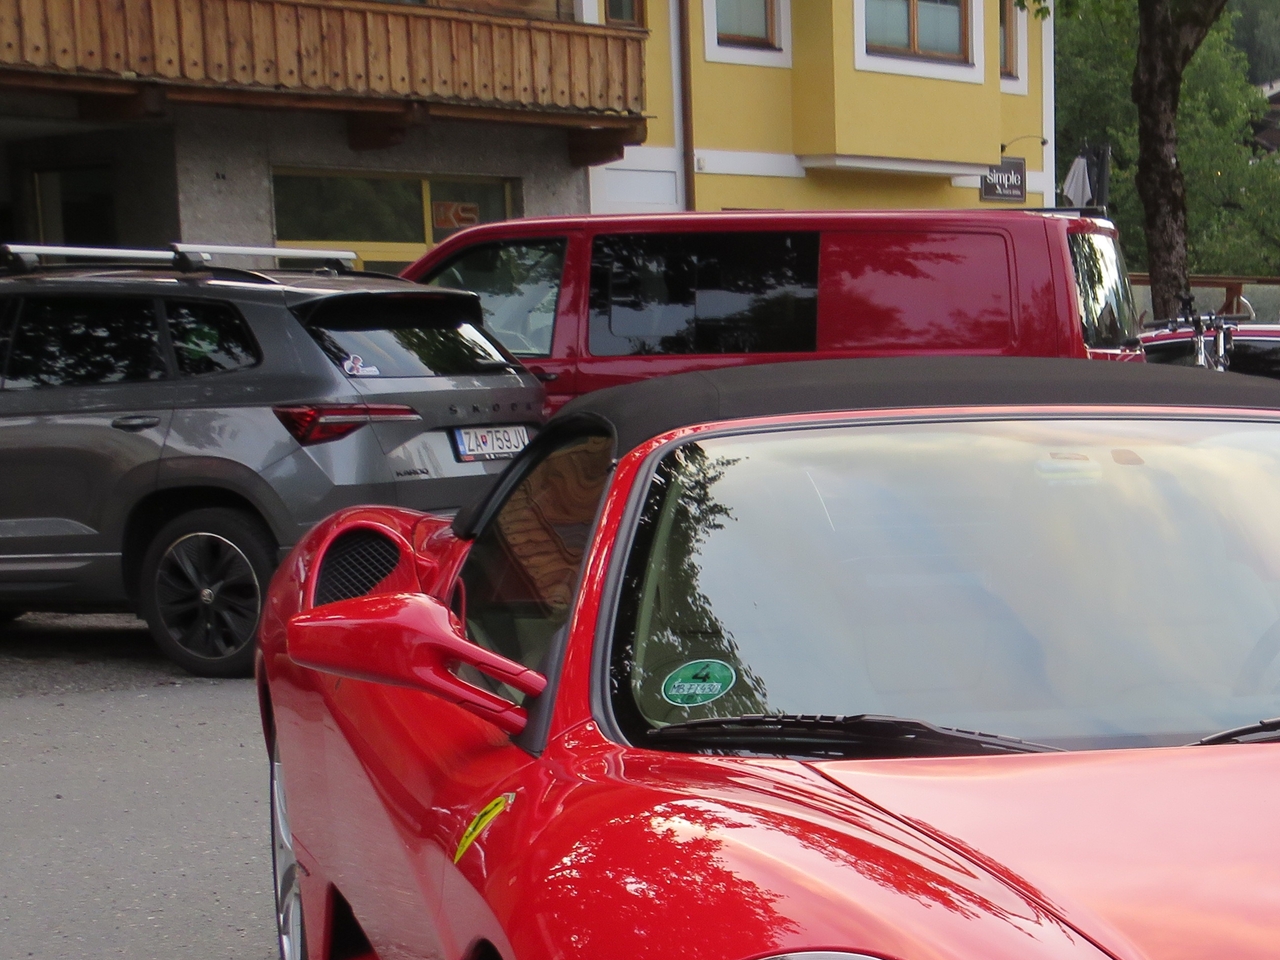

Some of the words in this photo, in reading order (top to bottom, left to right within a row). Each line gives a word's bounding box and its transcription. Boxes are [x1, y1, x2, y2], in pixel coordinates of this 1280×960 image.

[986, 170, 1021, 188] simple
[464, 430, 482, 453] ZA
[692, 663, 711, 682] 4
